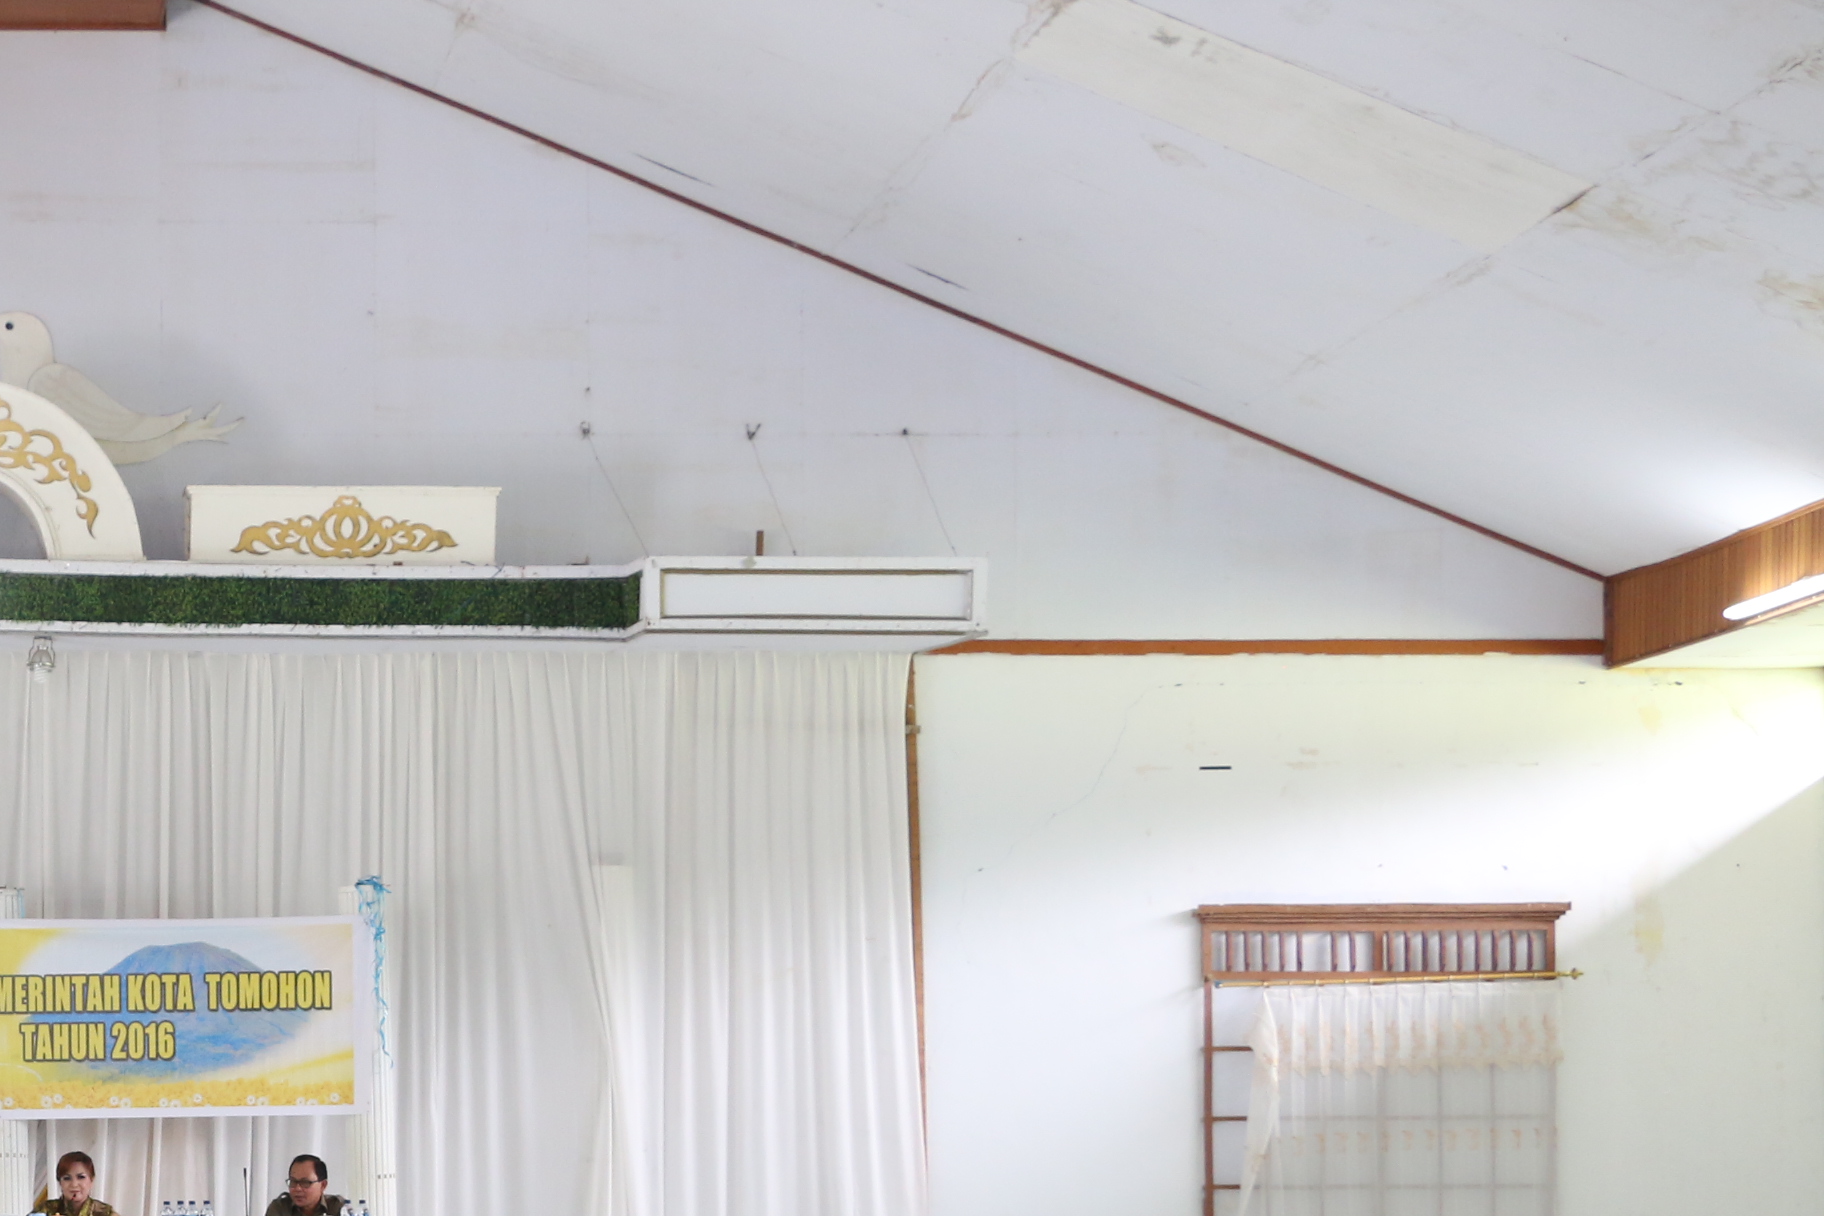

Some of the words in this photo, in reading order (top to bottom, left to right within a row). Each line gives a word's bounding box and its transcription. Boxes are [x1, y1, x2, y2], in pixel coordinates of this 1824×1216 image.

[126, 972, 195, 1013] KOTA
[204, 970, 333, 1012] TOMOHON
[19, 1021, 106, 1062] TAHUN
[111, 1020, 176, 1061] 2016
